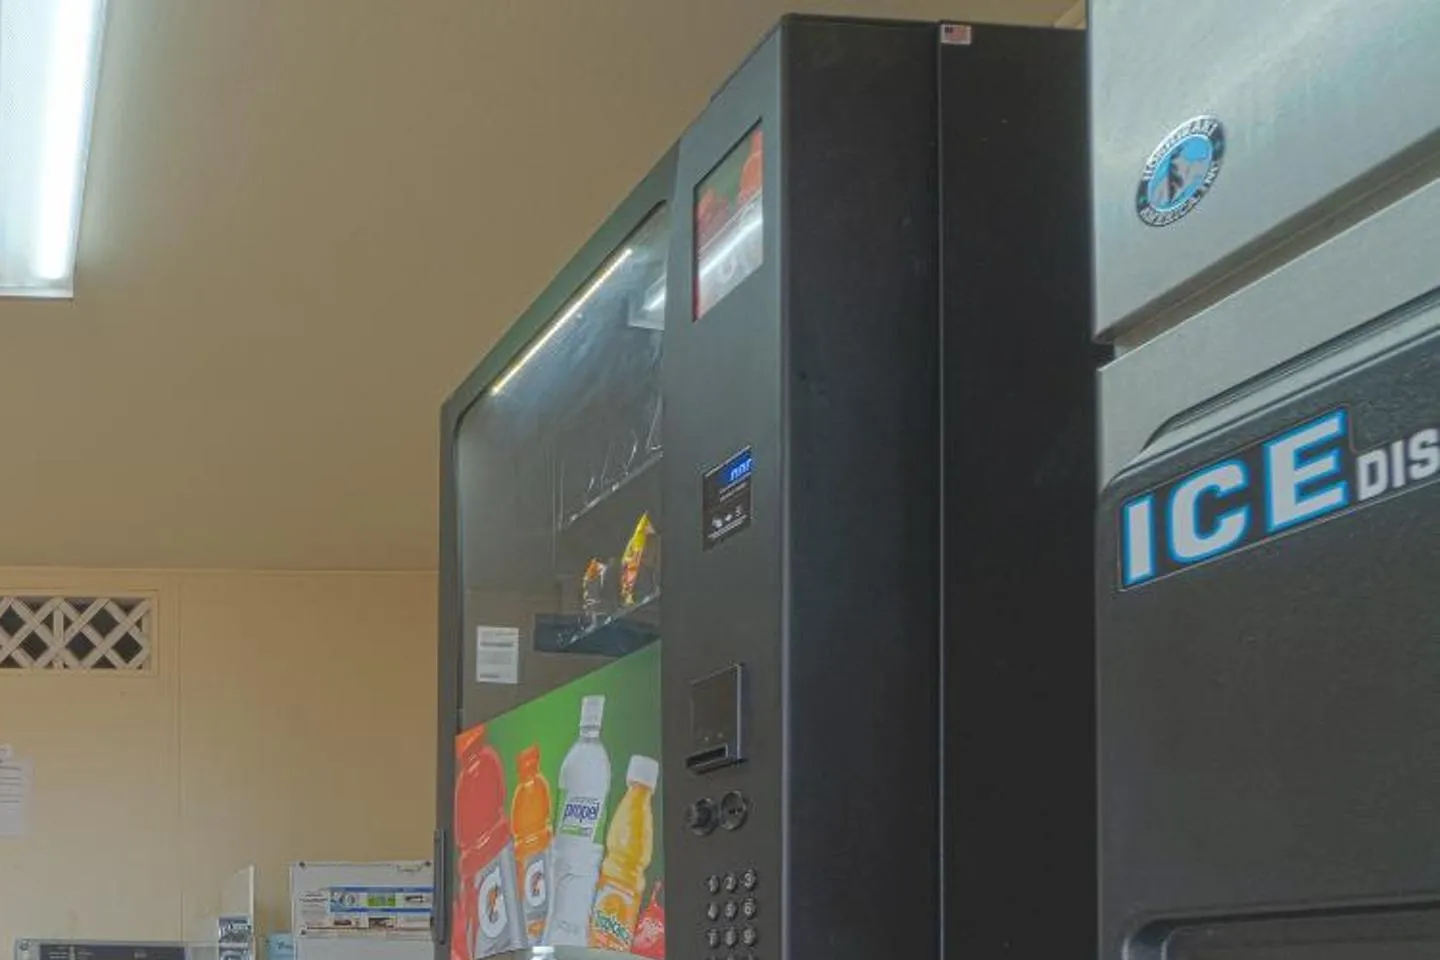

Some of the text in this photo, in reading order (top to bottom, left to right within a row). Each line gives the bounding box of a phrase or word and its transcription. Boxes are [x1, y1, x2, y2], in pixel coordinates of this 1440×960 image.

[1122, 408, 1440, 588] ICE DIS
[564, 801, 599, 823] propel
